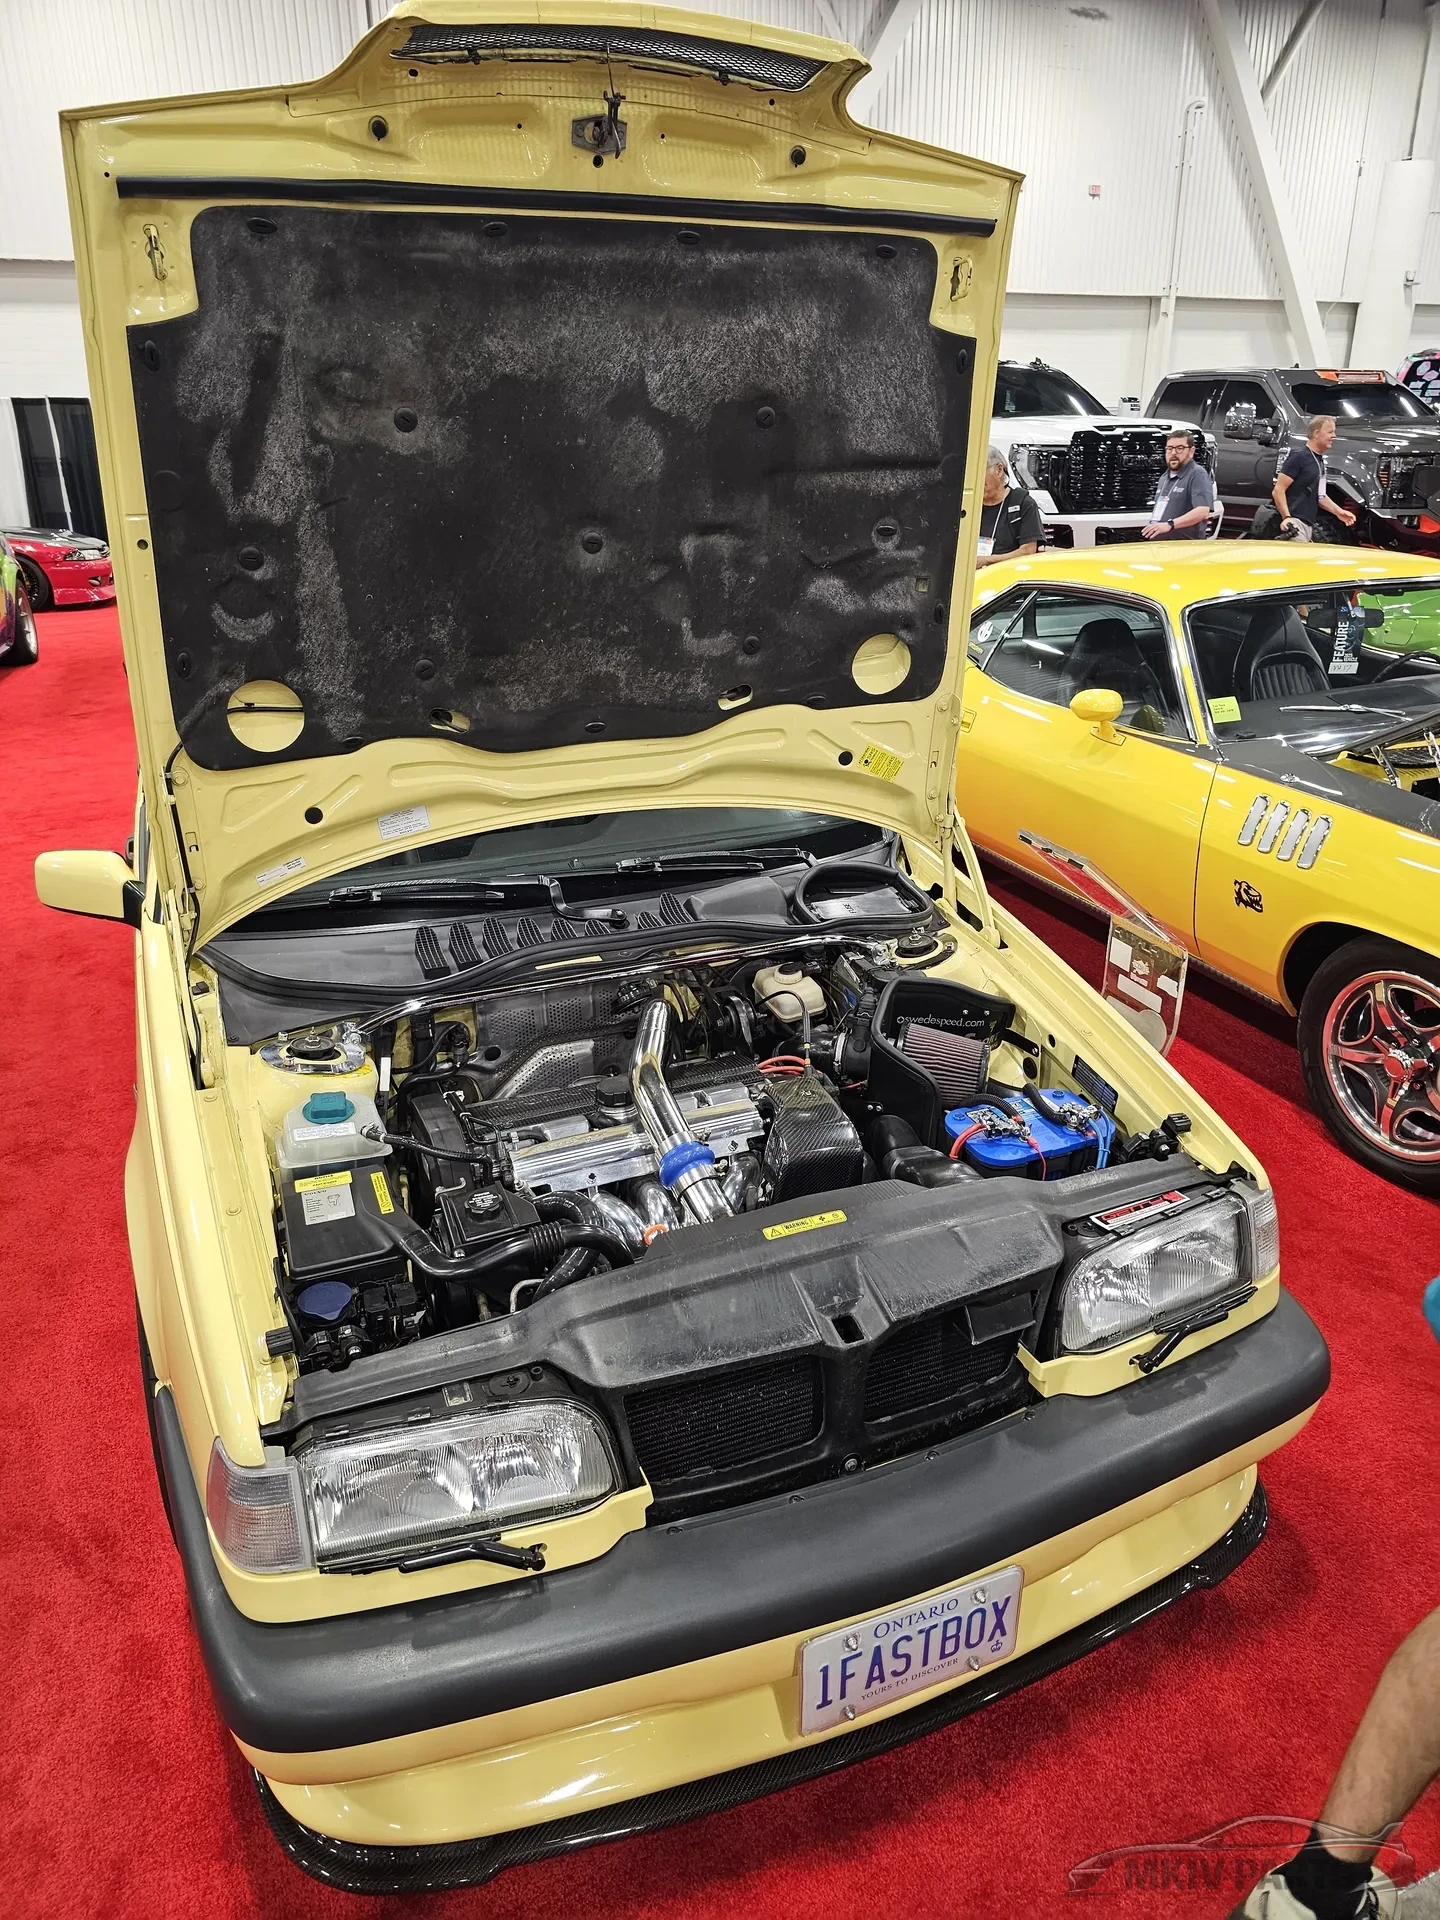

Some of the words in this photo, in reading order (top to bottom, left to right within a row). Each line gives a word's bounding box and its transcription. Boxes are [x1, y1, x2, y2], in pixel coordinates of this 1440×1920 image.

[1332, 621, 1350, 662] FEATURE
[905, 1013, 985, 1028] swedespeed.com
[873, 1598, 959, 1639] ONTARIO
[816, 1596, 1012, 1710] 1FASTBOX
[861, 1685, 893, 1701] YOURS
[895, 1677, 909, 1688] TO
[911, 1657, 959, 1681] DISCOVER
